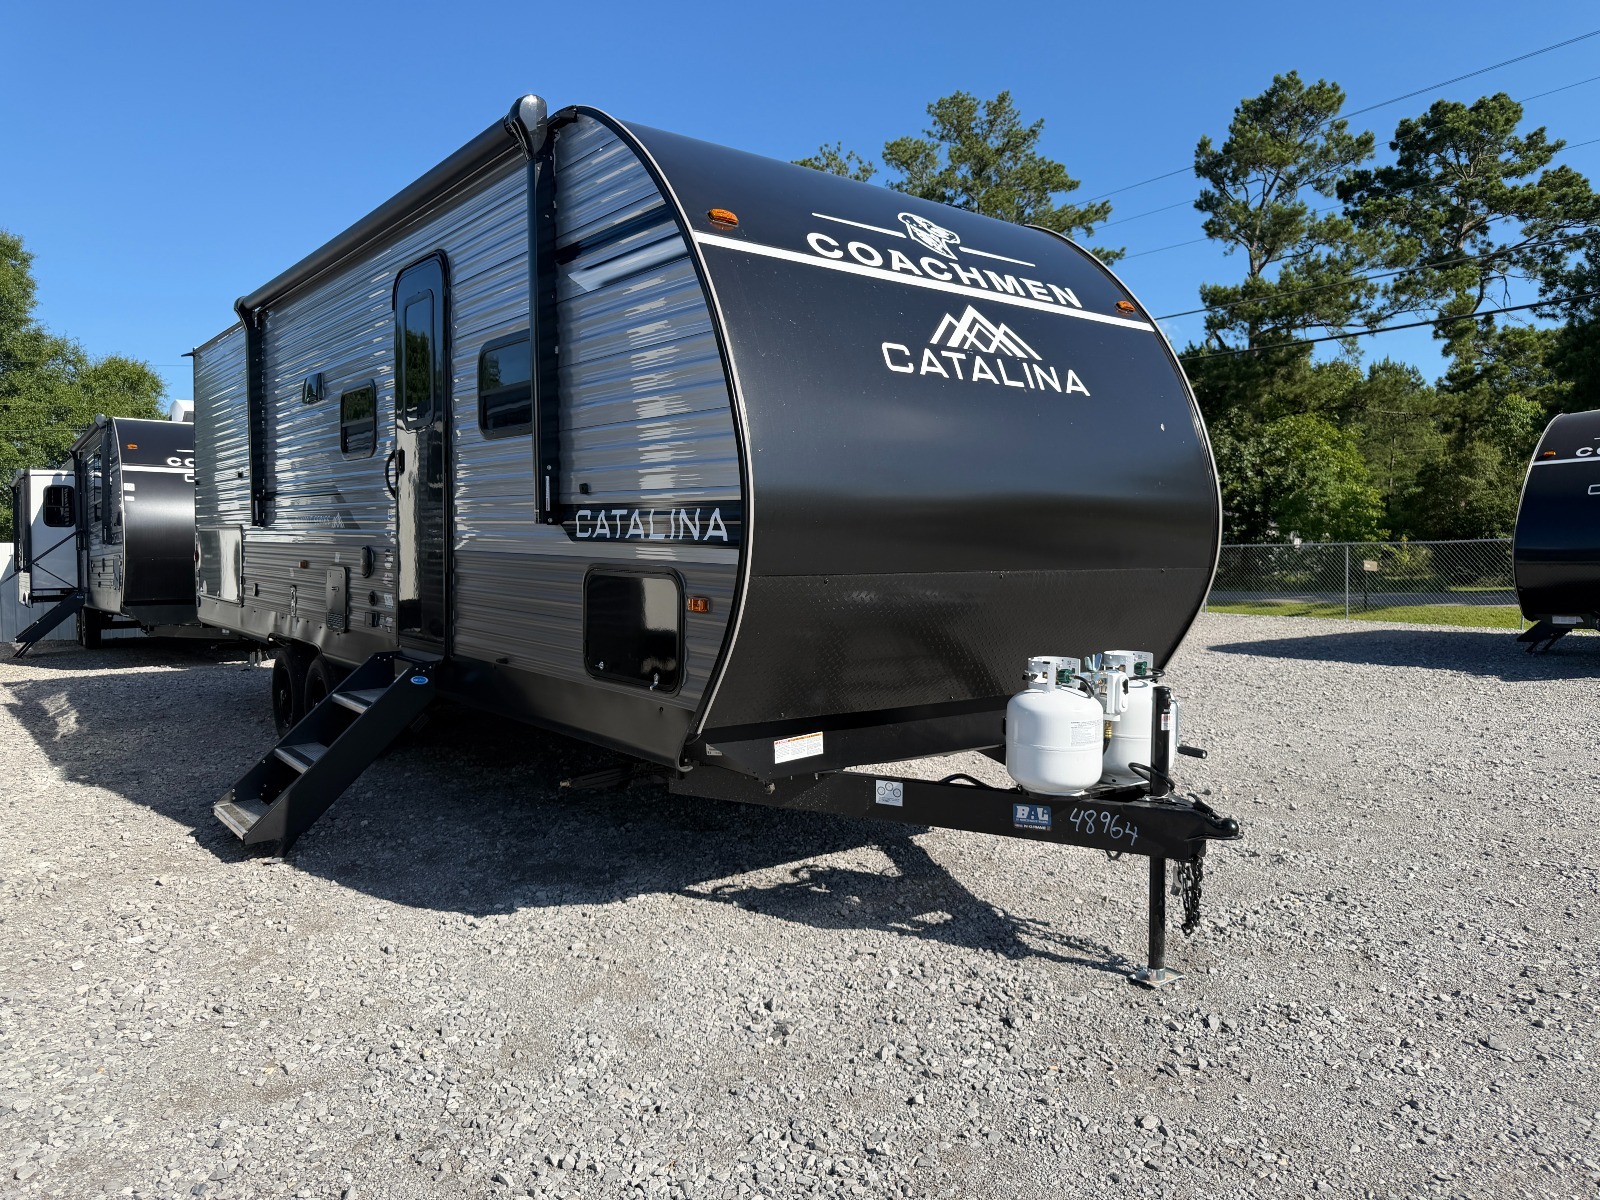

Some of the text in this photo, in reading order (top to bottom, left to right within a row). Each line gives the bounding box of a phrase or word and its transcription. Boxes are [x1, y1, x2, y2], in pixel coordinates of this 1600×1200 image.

[806, 232, 1083, 308] COACHMEN
[881, 342, 1091, 397] CATALINA
[575, 508, 728, 541] CATALINA
[1069, 807, 1138, 846] 48964
